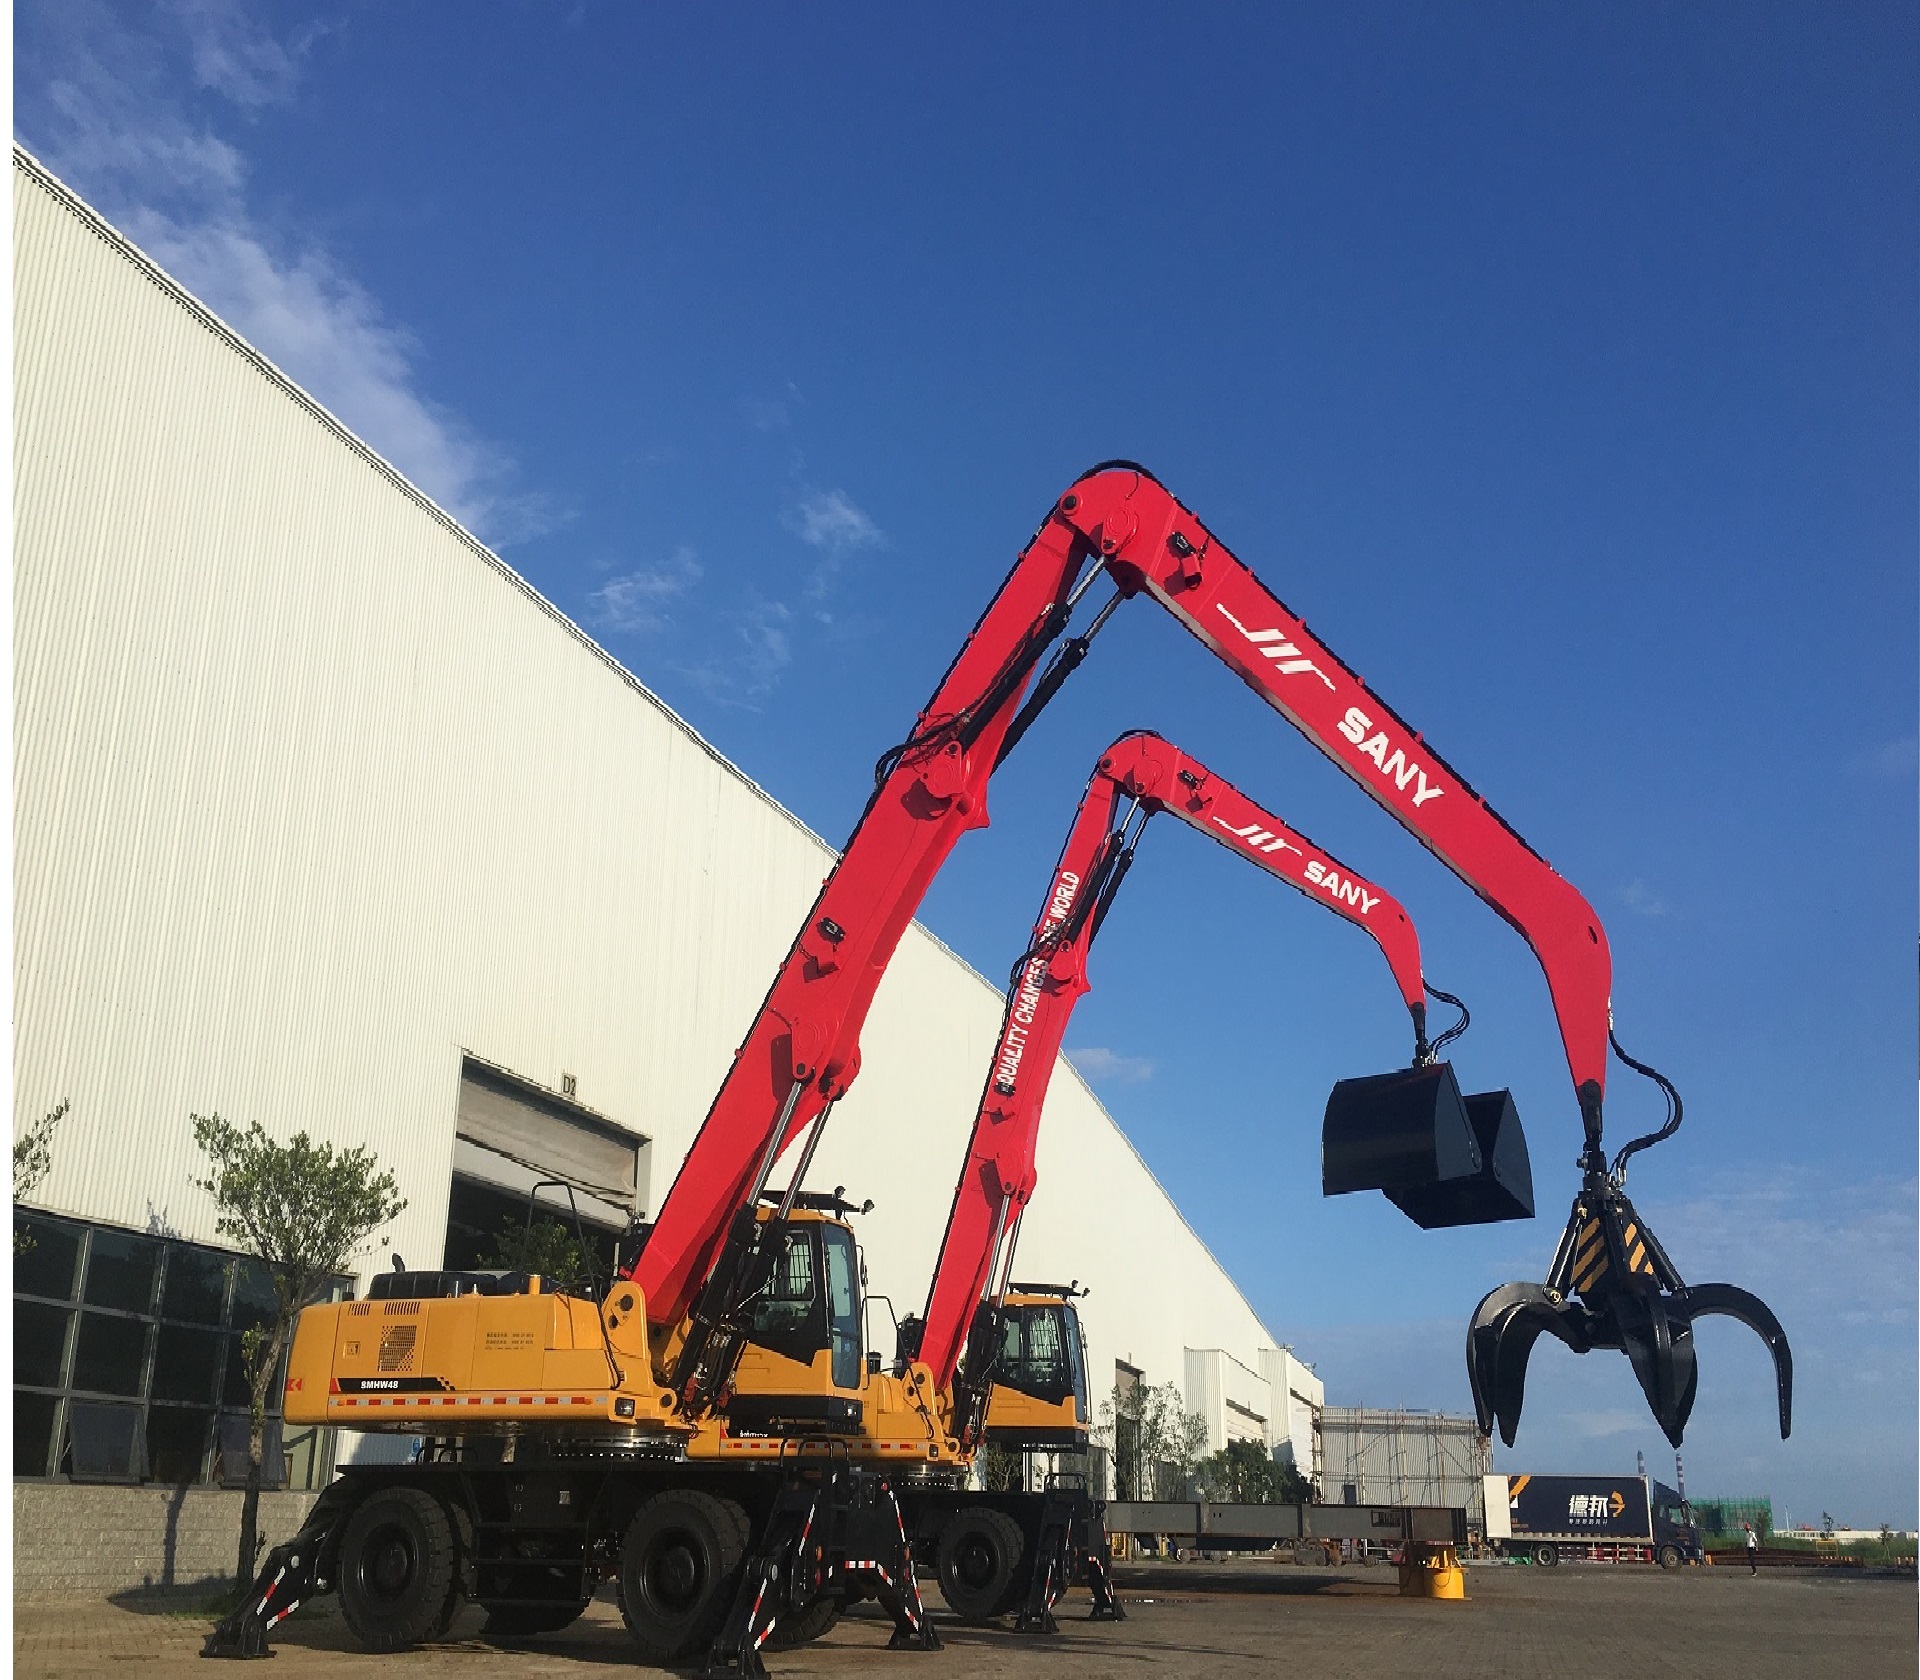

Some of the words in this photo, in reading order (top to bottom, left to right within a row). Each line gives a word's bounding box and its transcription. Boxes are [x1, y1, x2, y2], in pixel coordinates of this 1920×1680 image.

[1337, 707, 1444, 807] SANY
[1303, 860, 1380, 914] SANY
[996, 1023, 1029, 1086] QUALITY
[1015, 957, 1048, 1024] CHANGES
[1050, 871, 1080, 920] WORLD
[563, 1075, 576, 1097] D2
[1569, 1494, 1608, 1518] 德邦
